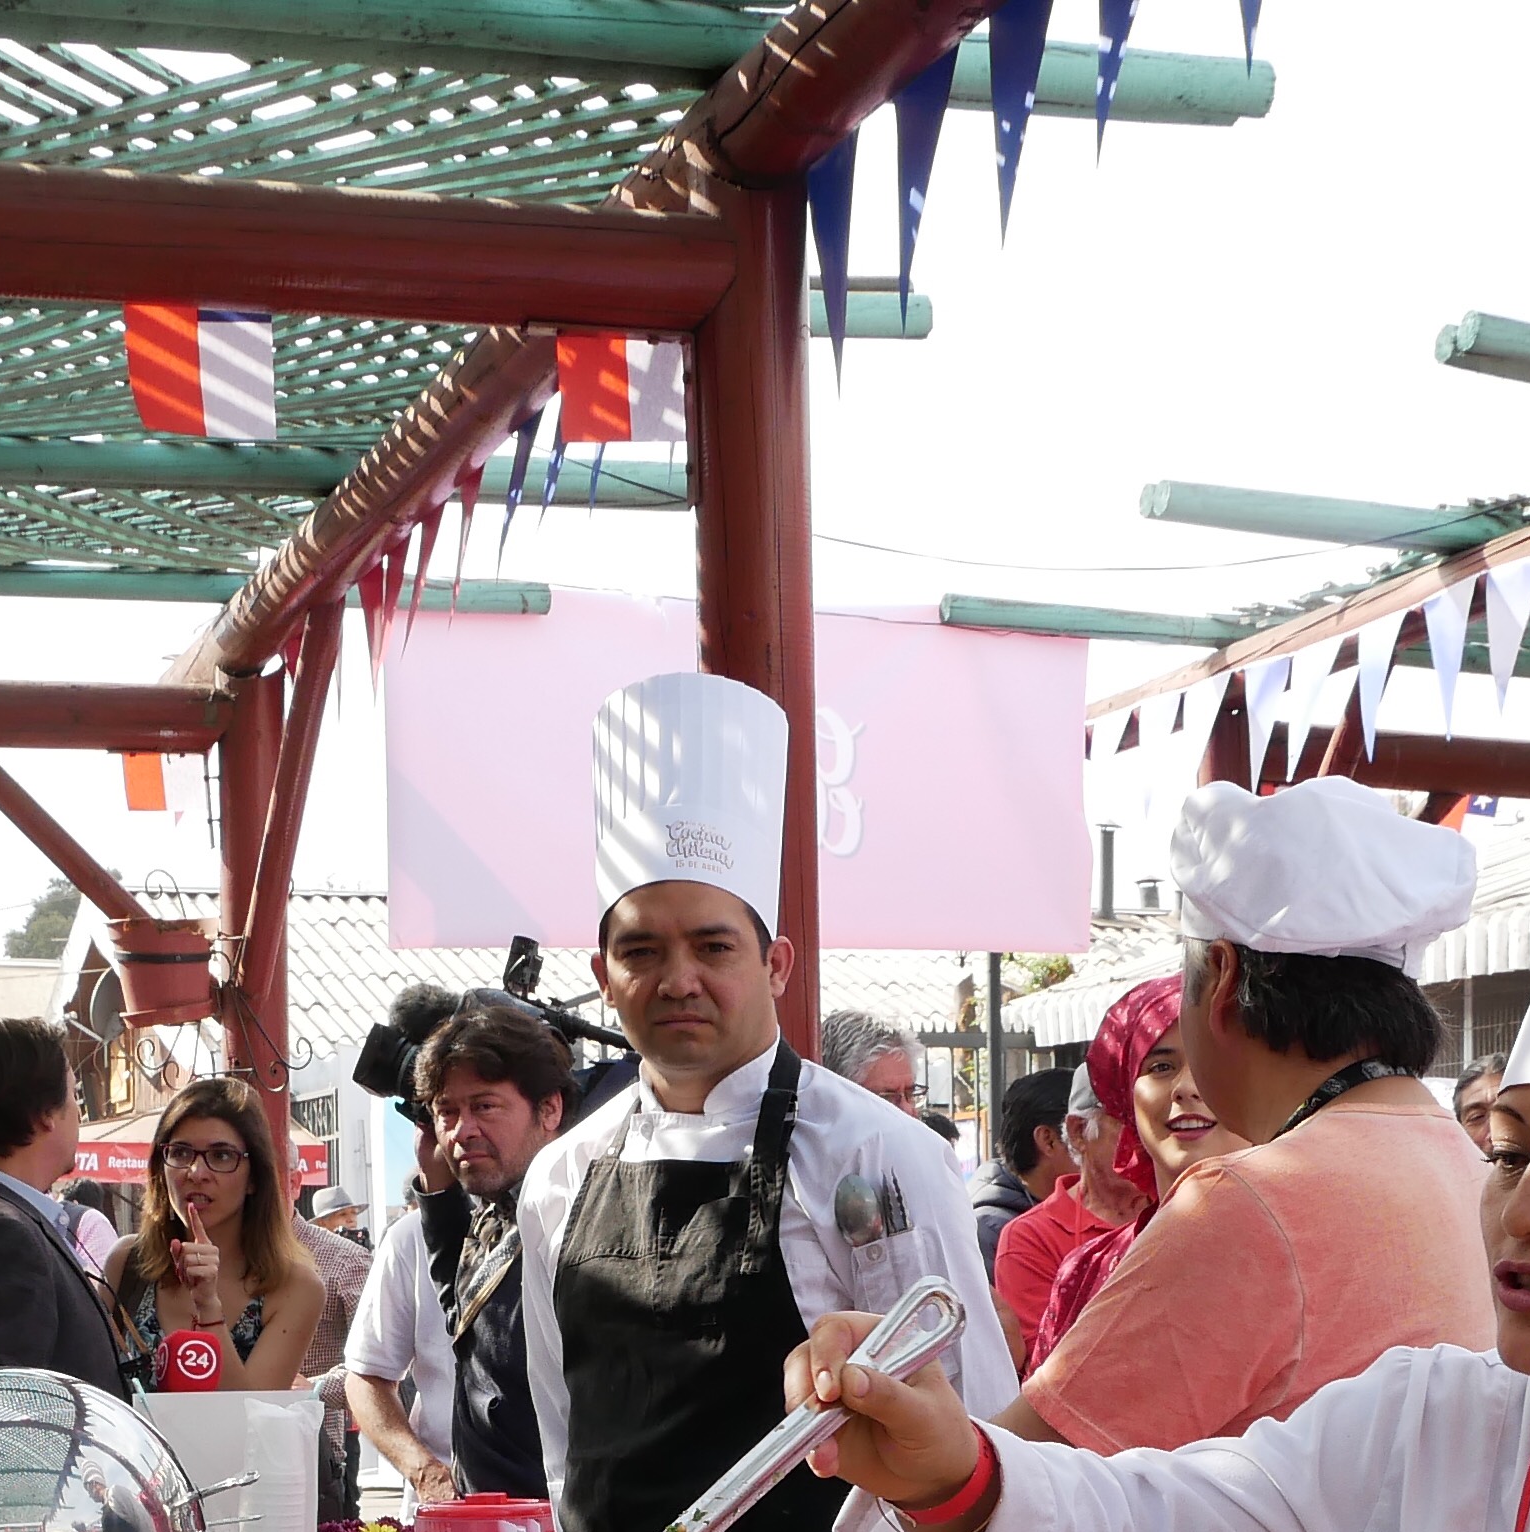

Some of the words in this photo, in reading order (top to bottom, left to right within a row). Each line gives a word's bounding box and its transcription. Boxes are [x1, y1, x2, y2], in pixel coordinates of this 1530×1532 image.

[666, 820, 732, 850] Cocina
[75, 1152, 99, 1171] TA
[185, 1350, 209, 1369] 24
